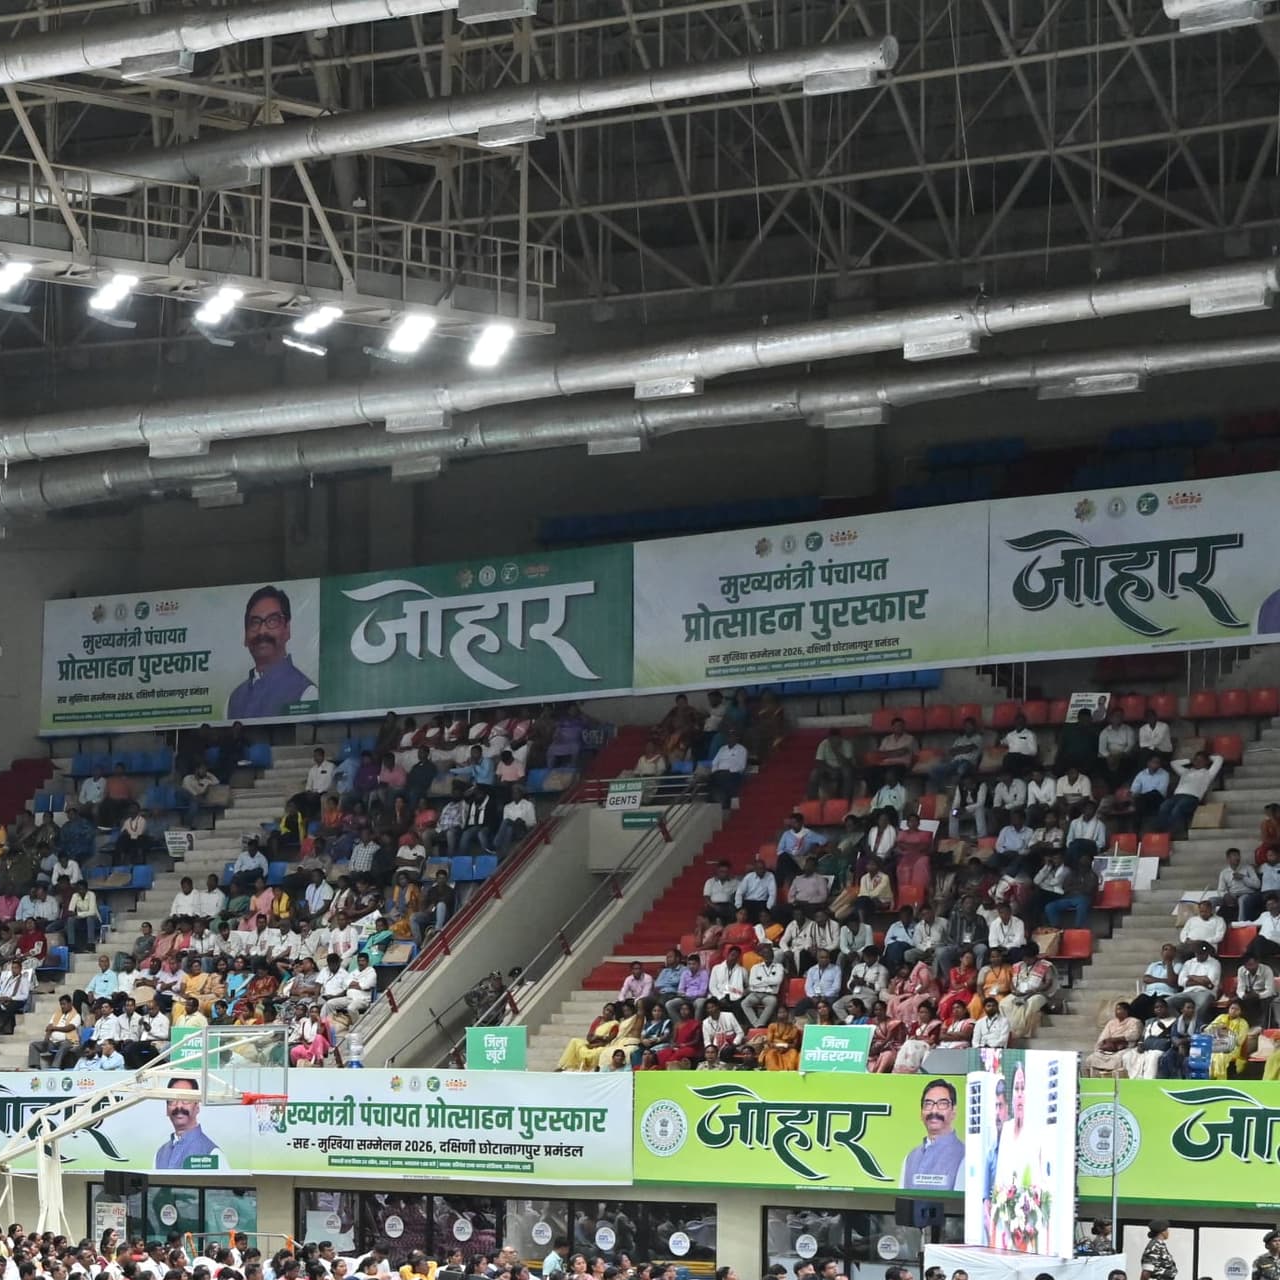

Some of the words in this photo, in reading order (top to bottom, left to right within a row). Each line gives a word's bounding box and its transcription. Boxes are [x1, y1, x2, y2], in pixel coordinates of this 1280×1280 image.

[719, 561, 815, 602] मुख्यमंत्री
[819, 558, 889, 585] पंचायत
[1005, 529, 1250, 635] जोहार
[682, 602, 805, 642] प्रोत्साहन
[811, 589, 928, 638] पुरस्कार
[82, 627, 142, 655] मुख्यमंत्री
[144, 627, 187, 645] पंचायत
[341, 579, 602, 690] जोहार
[58, 654, 135, 680] प्रोत्साहन
[138, 651, 211, 683] पुरस्कार
[609, 796, 637, 806] GENTS
[484, 1034, 508, 1048] जिला
[821, 1036, 850, 1049] जिला
[359, 1097, 422, 1128] पंचायत
[425, 1097, 515, 1130] प्रोत्साहन
[518, 1107, 608, 1138] पुरस्कार
[687, 1082, 894, 1181] जोहार
[318, 1138, 354, 1152] मुखिया
[357, 1140, 402, 1151] सम्मेलन
[440, 1142, 476, 1153] दक्षिणी
[479, 1143, 541, 1159] छोटानागपुर
[544, 1146, 583, 1157] प्रमंडल
